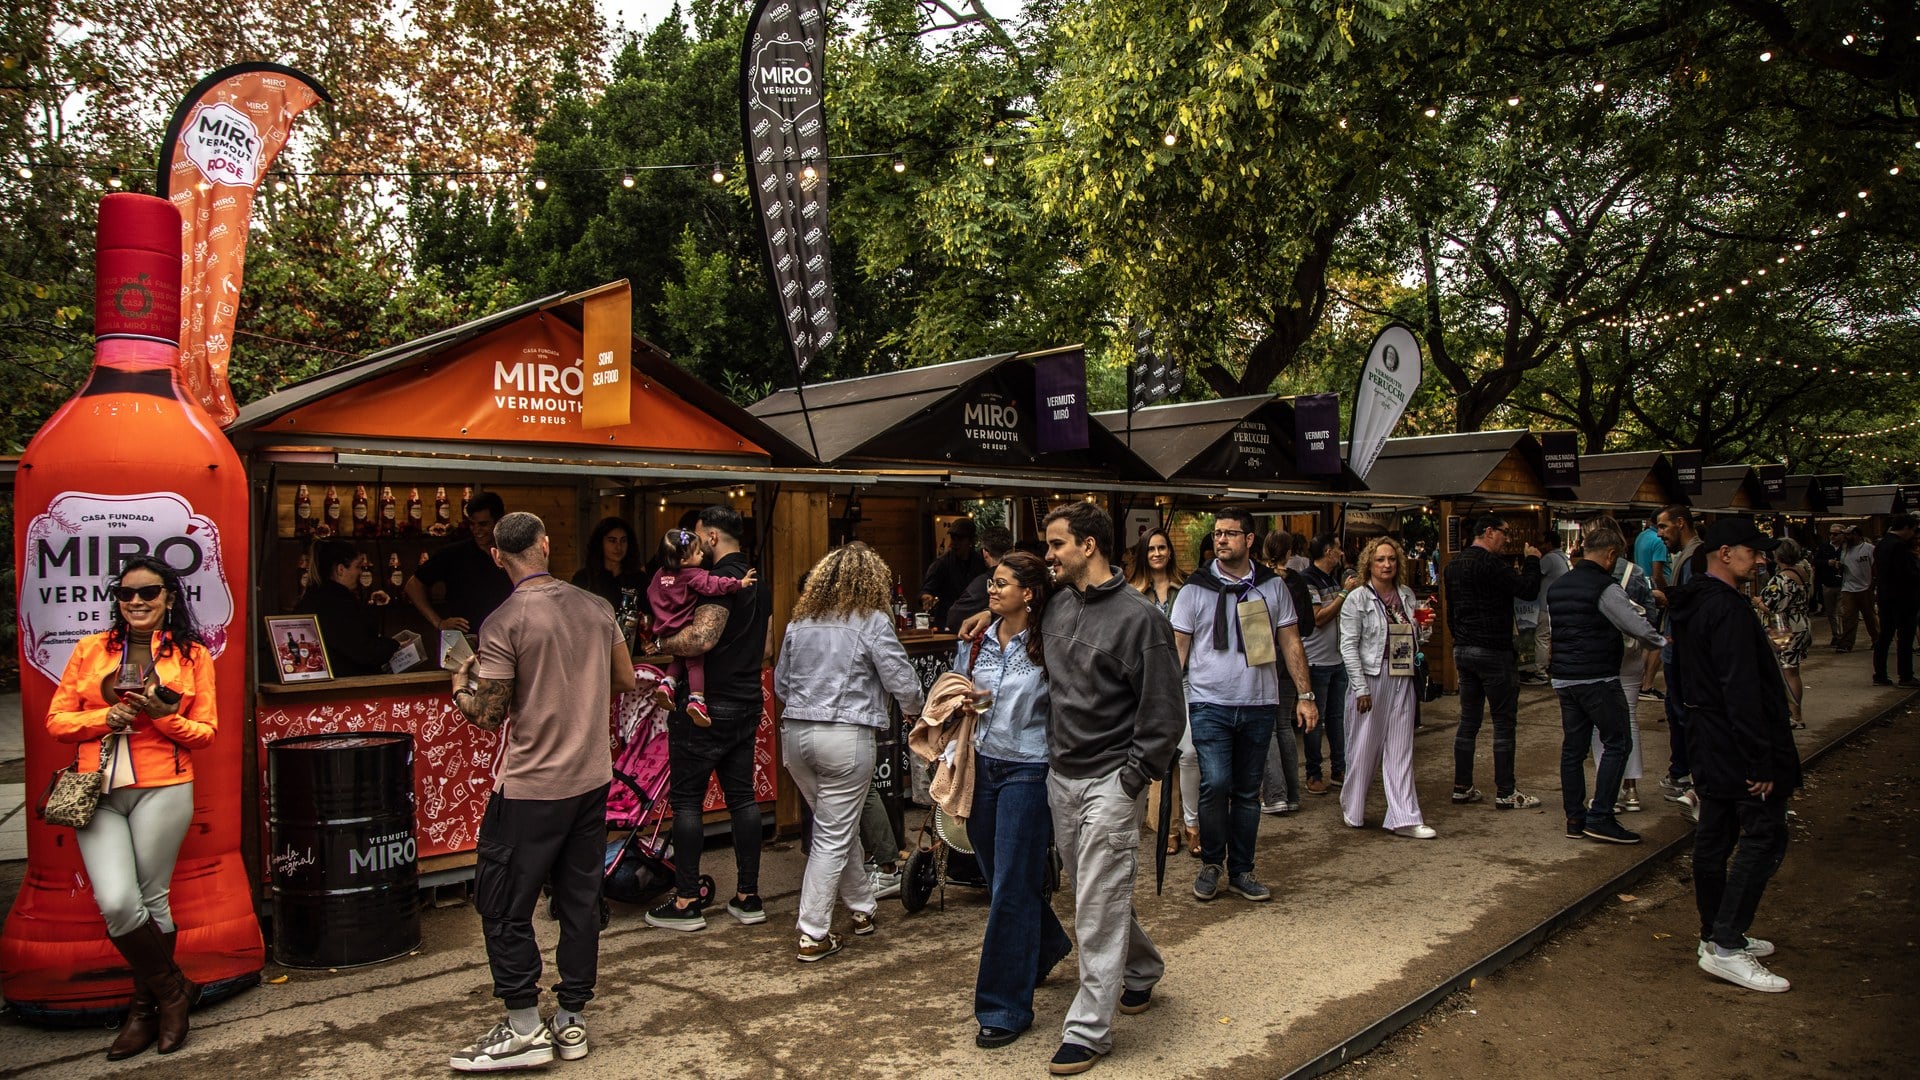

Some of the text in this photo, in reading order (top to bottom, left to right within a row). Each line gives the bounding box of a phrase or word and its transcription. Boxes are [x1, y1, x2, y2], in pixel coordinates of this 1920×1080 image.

[763, 86, 813, 96] VERMOUTH
[598, 351, 615, 367] SOHO
[494, 358, 584, 396] MIRÓ
[592, 369, 620, 387] SEA FOOD
[1374, 367, 1402, 390] VERMOUTH
[1368, 371, 1406, 403] PERUCCHI
[1046, 393, 1076, 408] VERMUTS
[522, 415, 567, 425] DE REUS
[964, 400, 1018, 429] MIRÓ
[1053, 406, 1070, 421] MIRÓ
[965, 428, 1020, 442] VERMOUTH
[1233, 432, 1271, 445] PERUCCHI
[1304, 430, 1331, 441] VERMUTS
[1240, 445, 1267, 455] BARCELONA
[1310, 441, 1325, 451] MIRÓ
[81, 513, 155, 523] CASA FUNDADA
[39, 586, 201, 605] VERMH
[78, 610, 100, 622] DE
[58, 627, 92, 637] selección
[369, 830, 409, 845] VERMUTS
